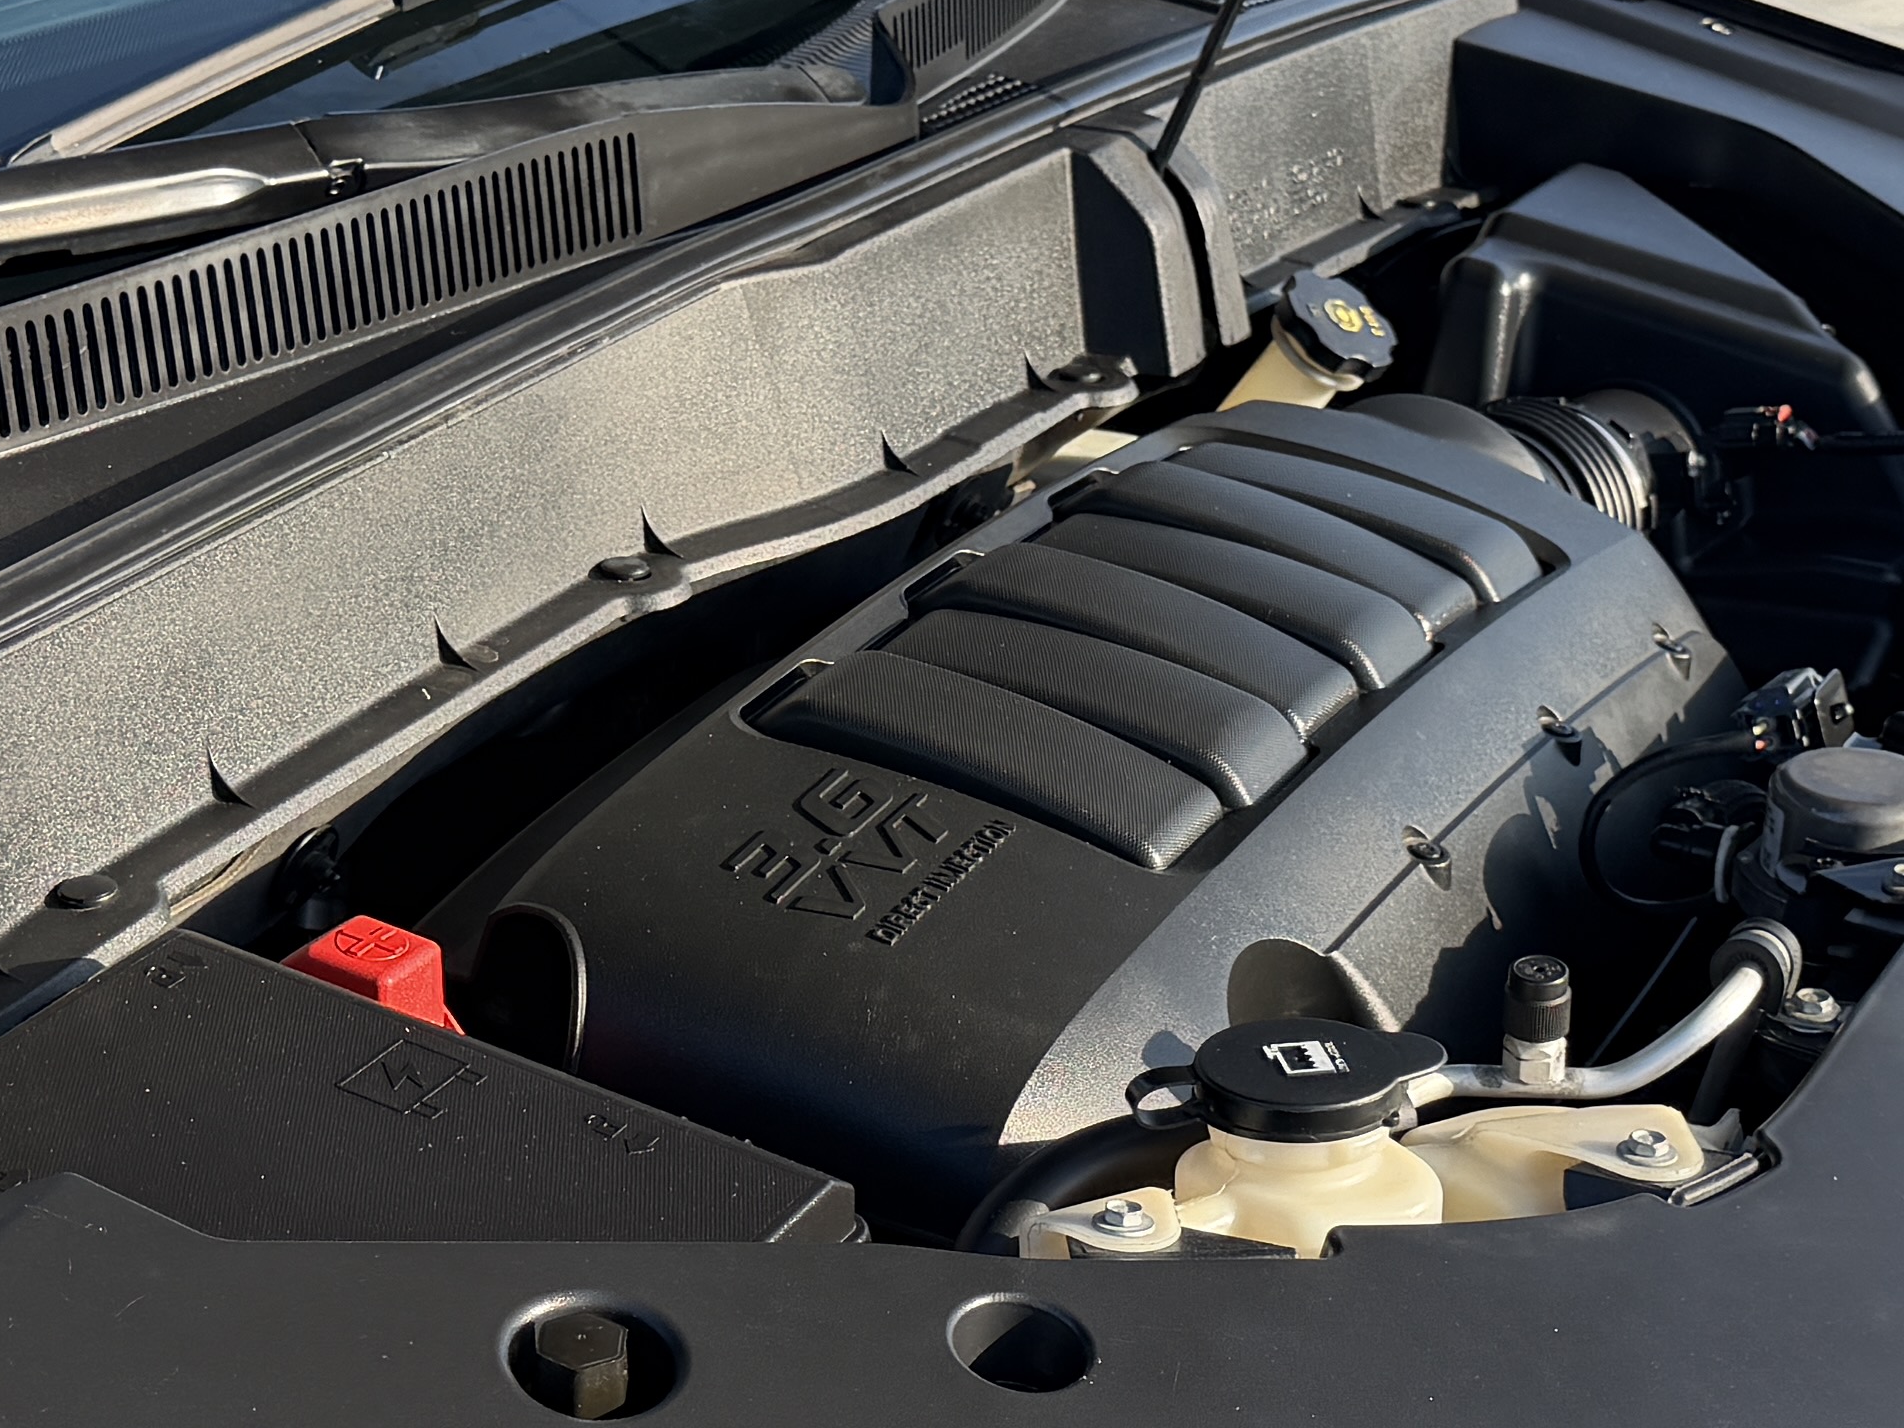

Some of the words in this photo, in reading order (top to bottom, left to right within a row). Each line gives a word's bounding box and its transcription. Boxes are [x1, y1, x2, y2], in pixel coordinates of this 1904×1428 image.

[718, 767, 894, 906] 3.6
[785, 792, 949, 921] VVT
[864, 885, 942, 947] DIRECT
[921, 819, 1017, 894] INJECTION
